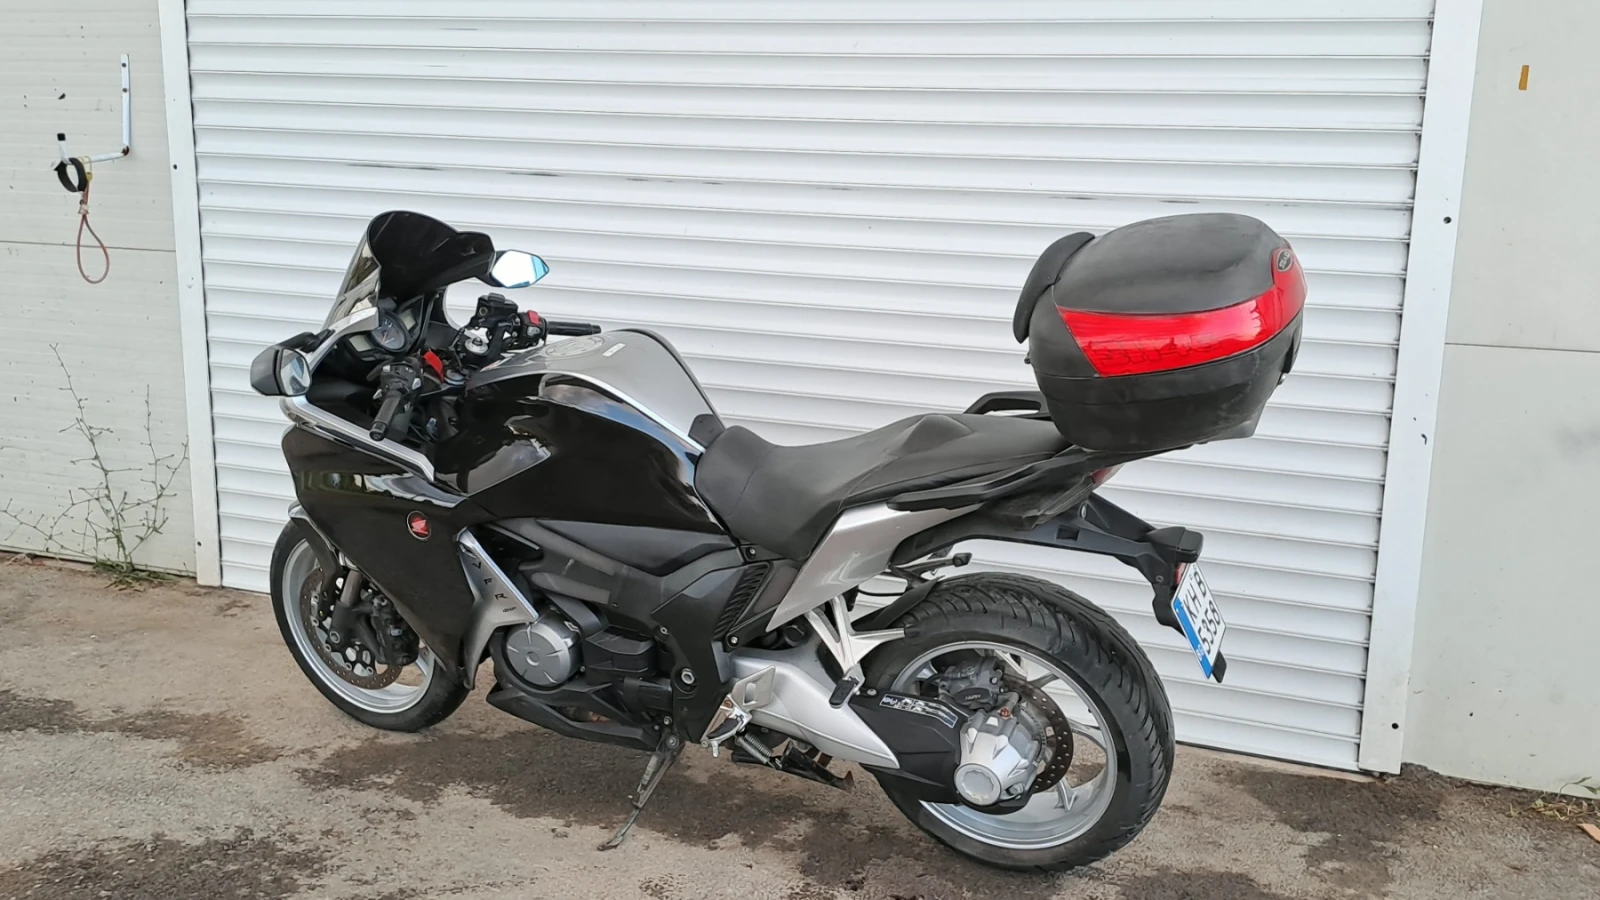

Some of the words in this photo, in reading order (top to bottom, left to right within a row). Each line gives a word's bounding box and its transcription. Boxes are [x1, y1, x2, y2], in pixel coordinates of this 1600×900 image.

[1183, 583, 1202, 624] KH
[1194, 571, 1206, 597] B
[1198, 600, 1220, 655] 5358
